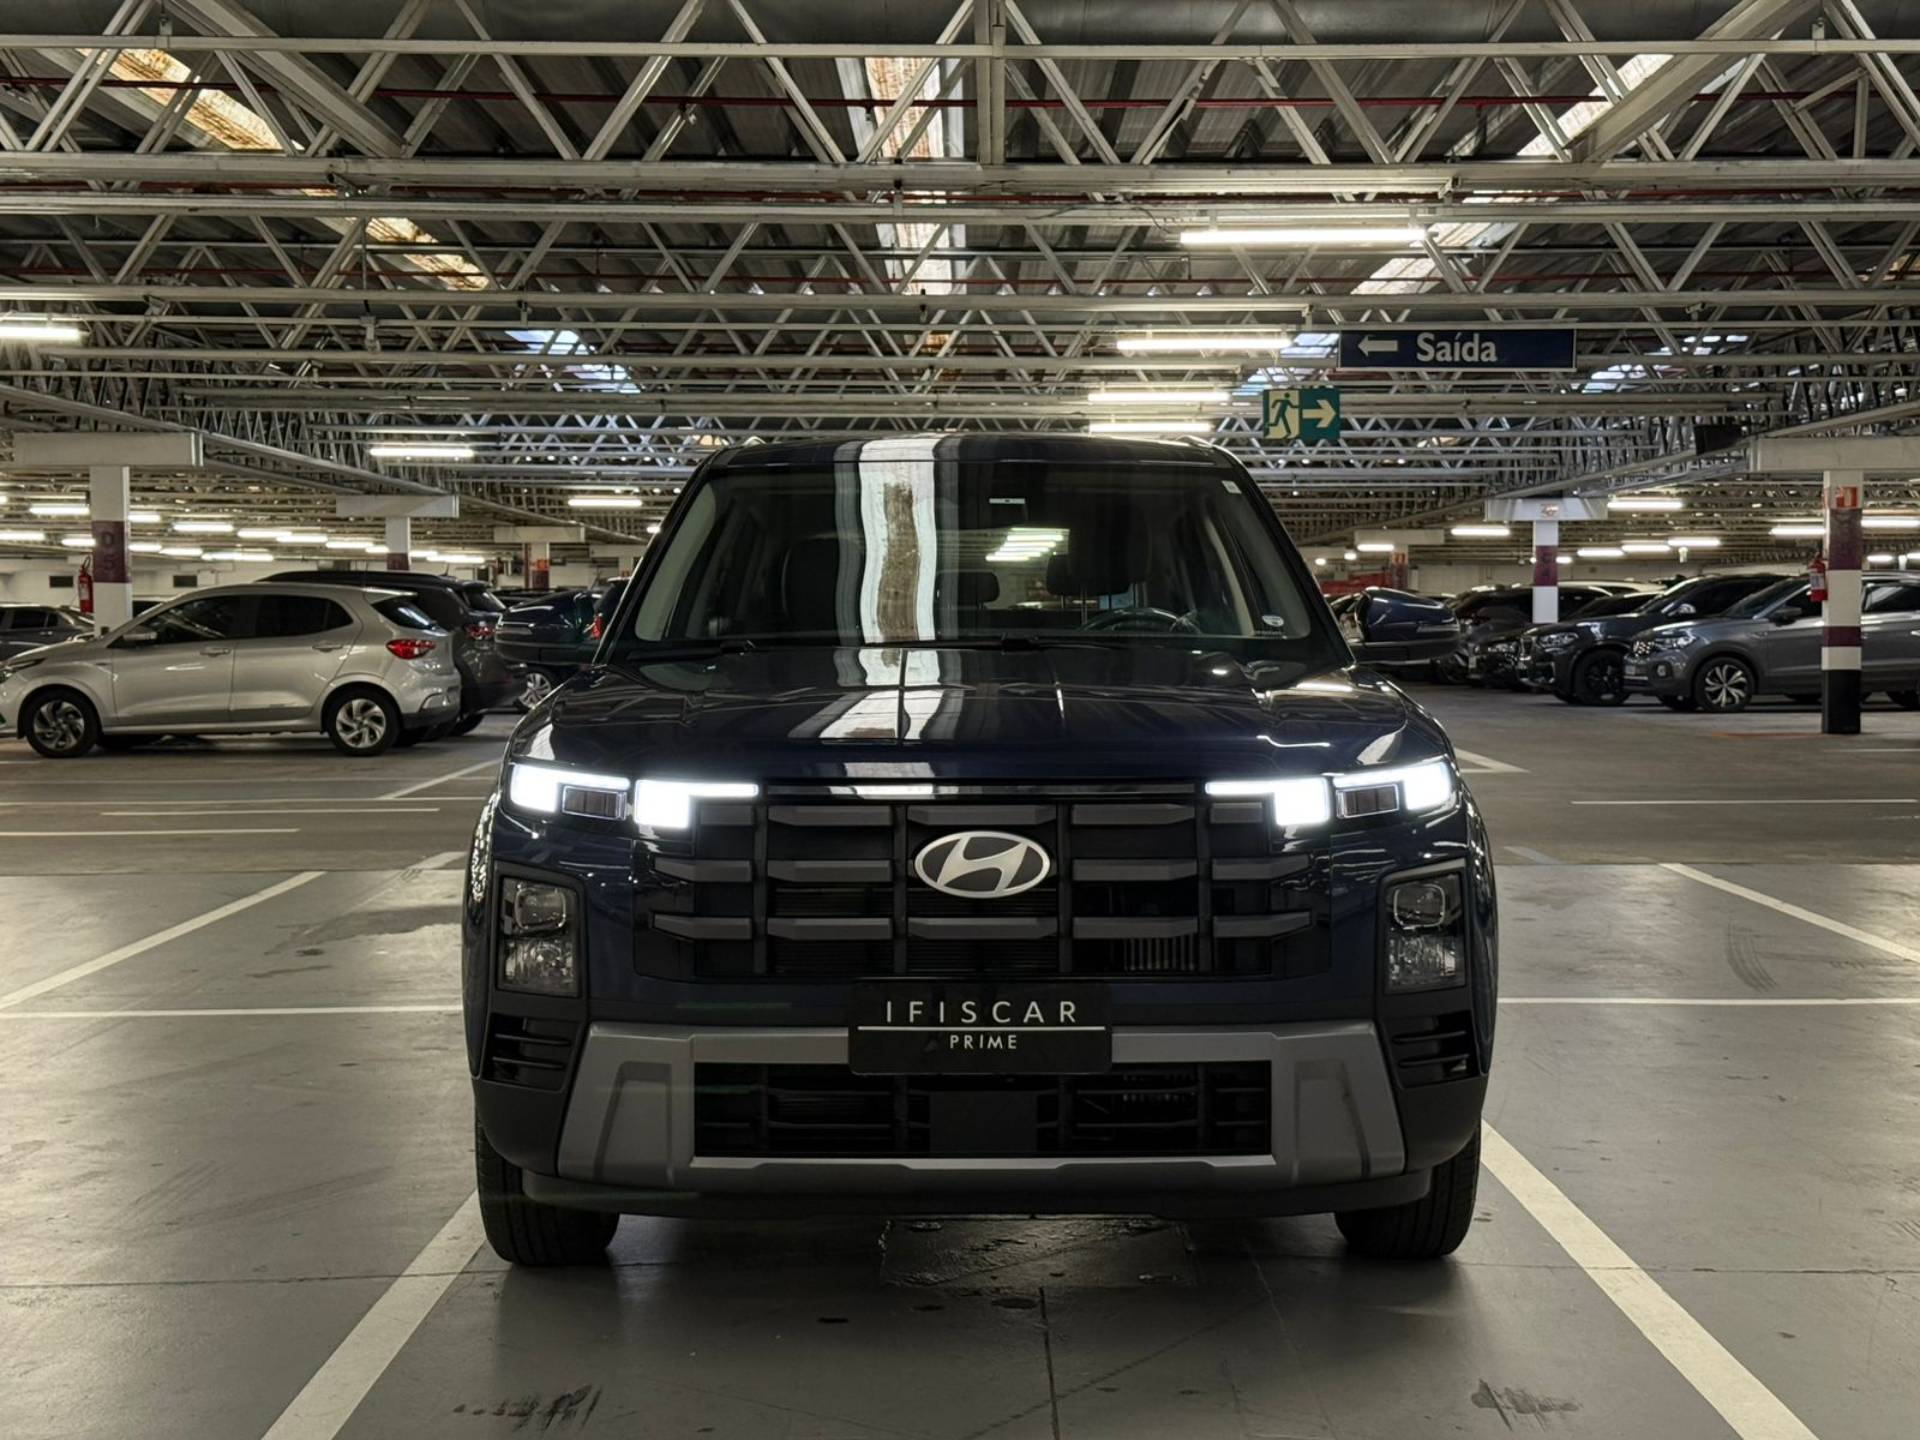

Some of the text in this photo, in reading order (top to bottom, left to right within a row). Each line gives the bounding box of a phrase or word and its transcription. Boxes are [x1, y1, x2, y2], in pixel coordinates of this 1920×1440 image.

[1416, 332, 1497, 362] Saída
[886, 1001, 1076, 1023] IFISCAR
[950, 1035, 1017, 1049] PRIME
